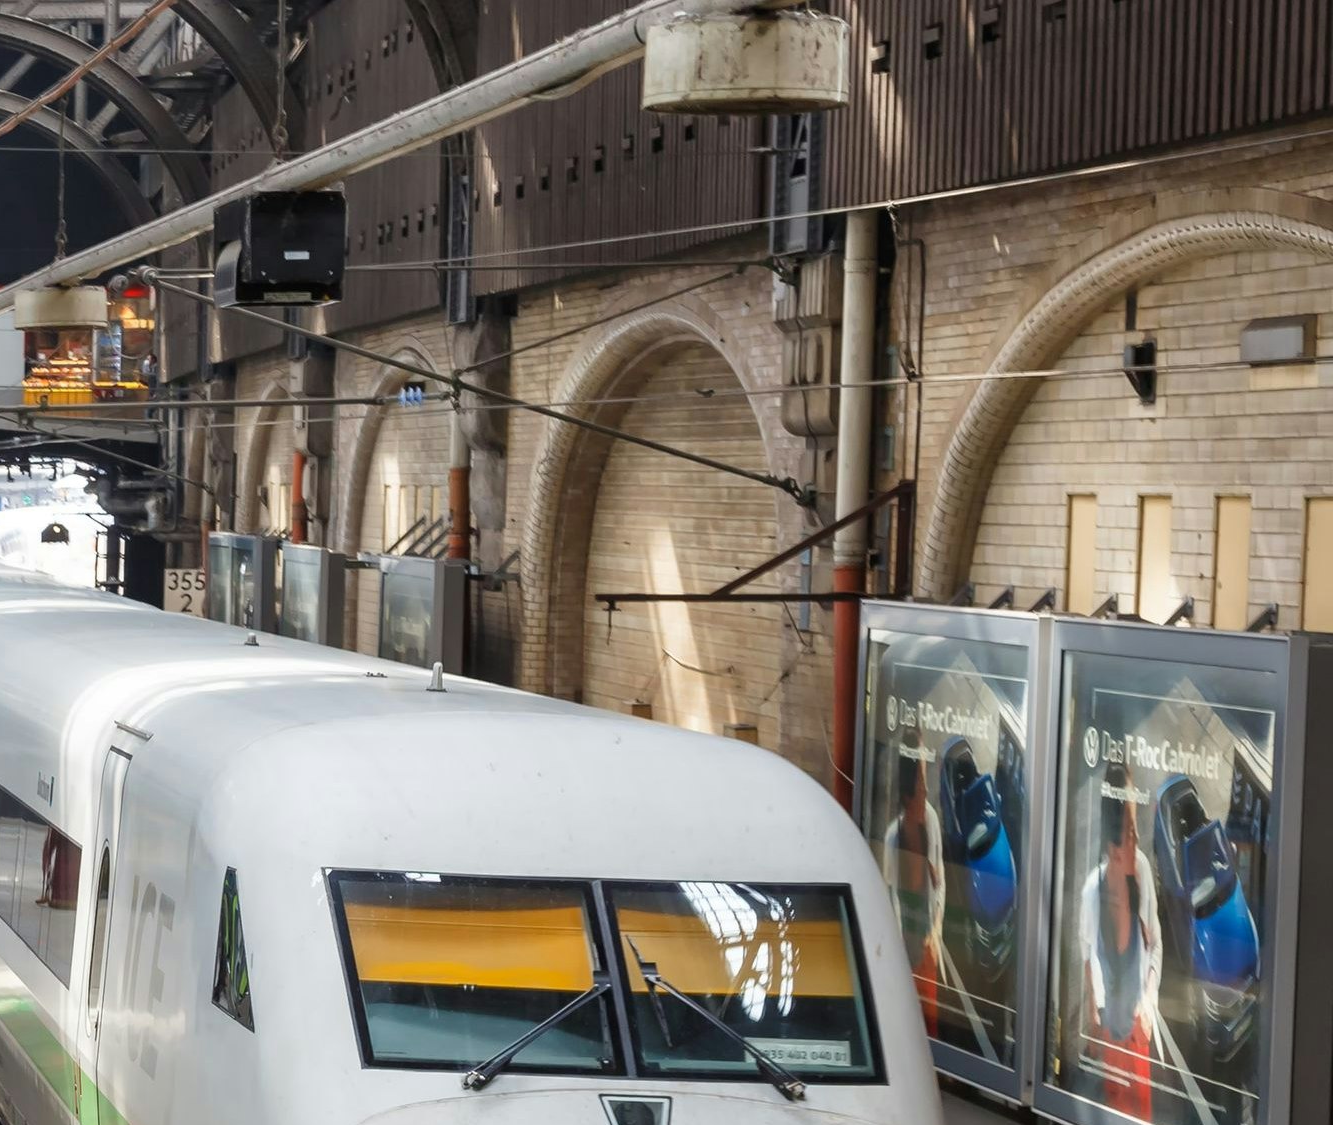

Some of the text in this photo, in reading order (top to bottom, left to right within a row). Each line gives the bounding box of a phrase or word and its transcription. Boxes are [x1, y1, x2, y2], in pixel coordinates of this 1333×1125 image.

[168, 571, 206, 591] 355
[180, 593, 193, 612] 2
[1102, 730, 1220, 780] Das T-Roc Cabriolet
